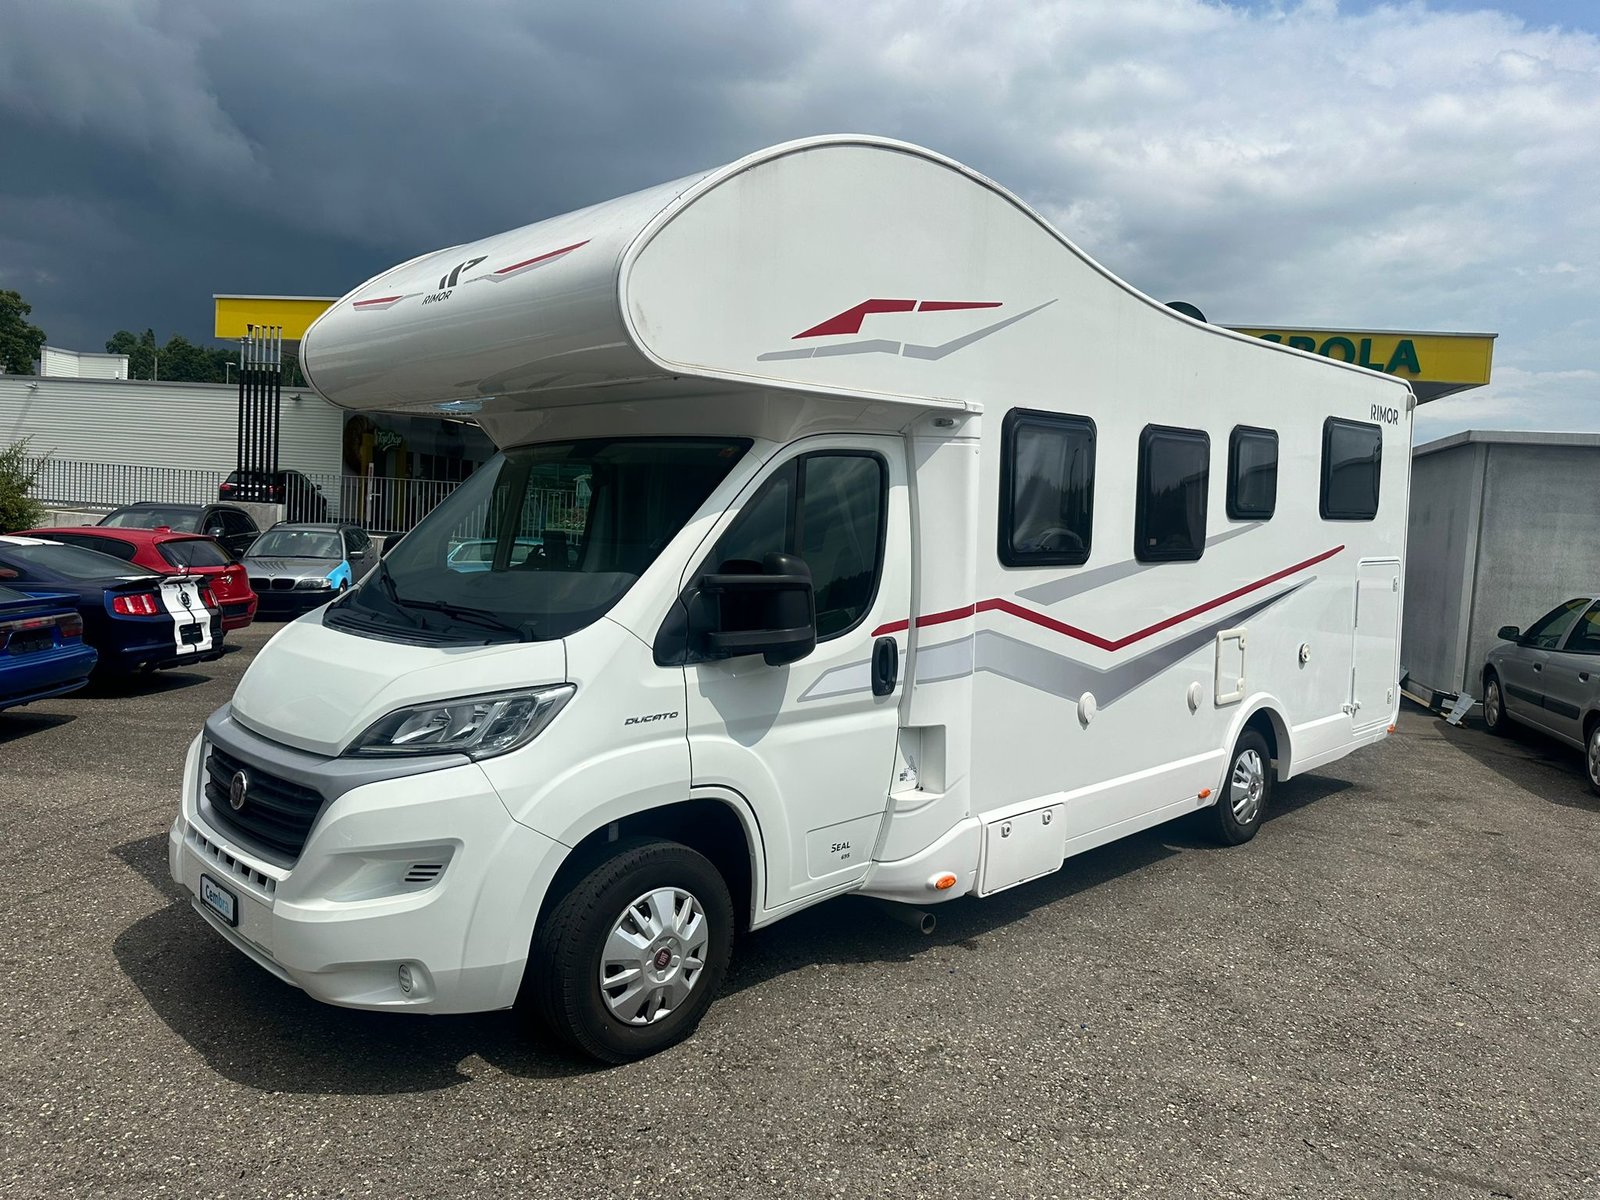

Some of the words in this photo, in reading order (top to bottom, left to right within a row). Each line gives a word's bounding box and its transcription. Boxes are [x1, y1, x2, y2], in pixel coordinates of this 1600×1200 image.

[421, 290, 453, 306] RIMOR
[1370, 403, 1399, 425] RIMOR
[624, 711, 678, 725] DUCATO
[831, 841, 851, 853] SEAL
